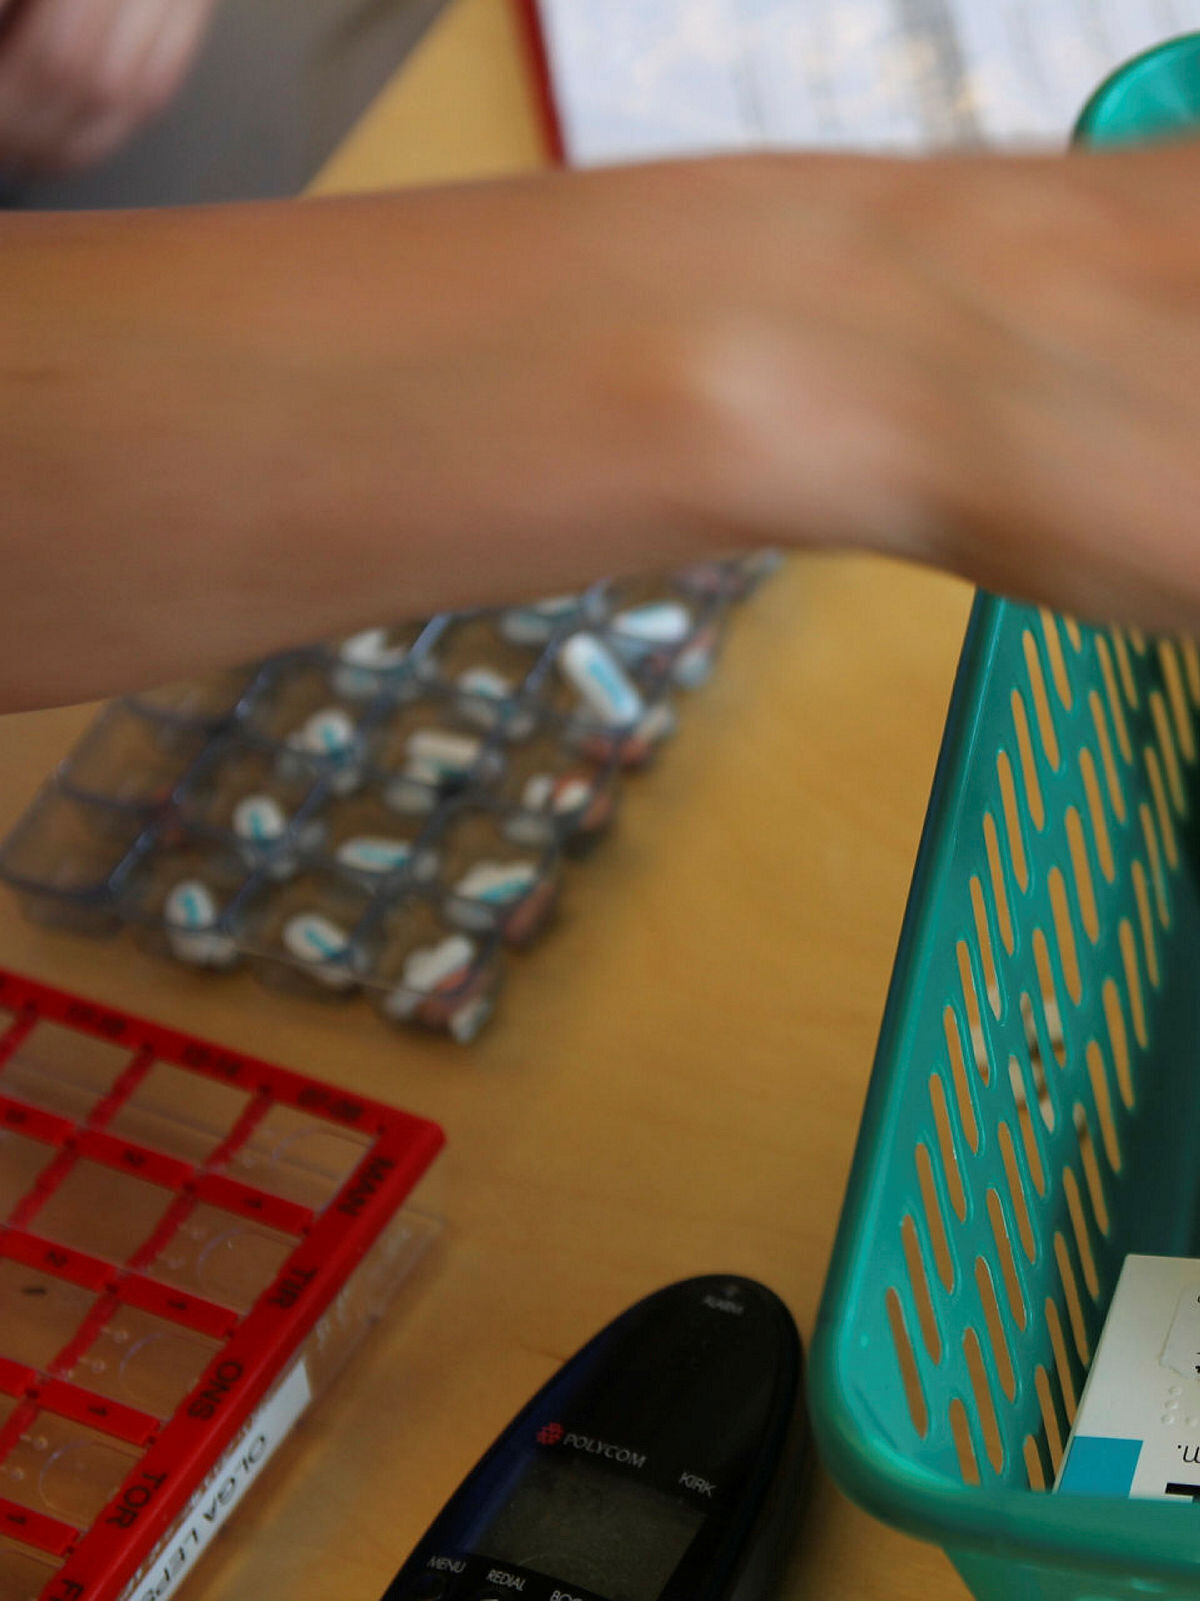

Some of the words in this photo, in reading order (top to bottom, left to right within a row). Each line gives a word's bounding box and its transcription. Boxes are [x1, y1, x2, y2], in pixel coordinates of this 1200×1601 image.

[338, 1156, 396, 1218] MAN
[267, 1267, 318, 1310] TIR
[187, 1360, 243, 1421] ONS
[563, 1432, 648, 1469] POLYCOM
[202, 1434, 267, 1523] OLGA
[679, 1471, 718, 1497] KIRK
[105, 1472, 169, 1530] TOR
[427, 1555, 467, 1575] MENU
[486, 1568, 527, 1592] REDIAL
